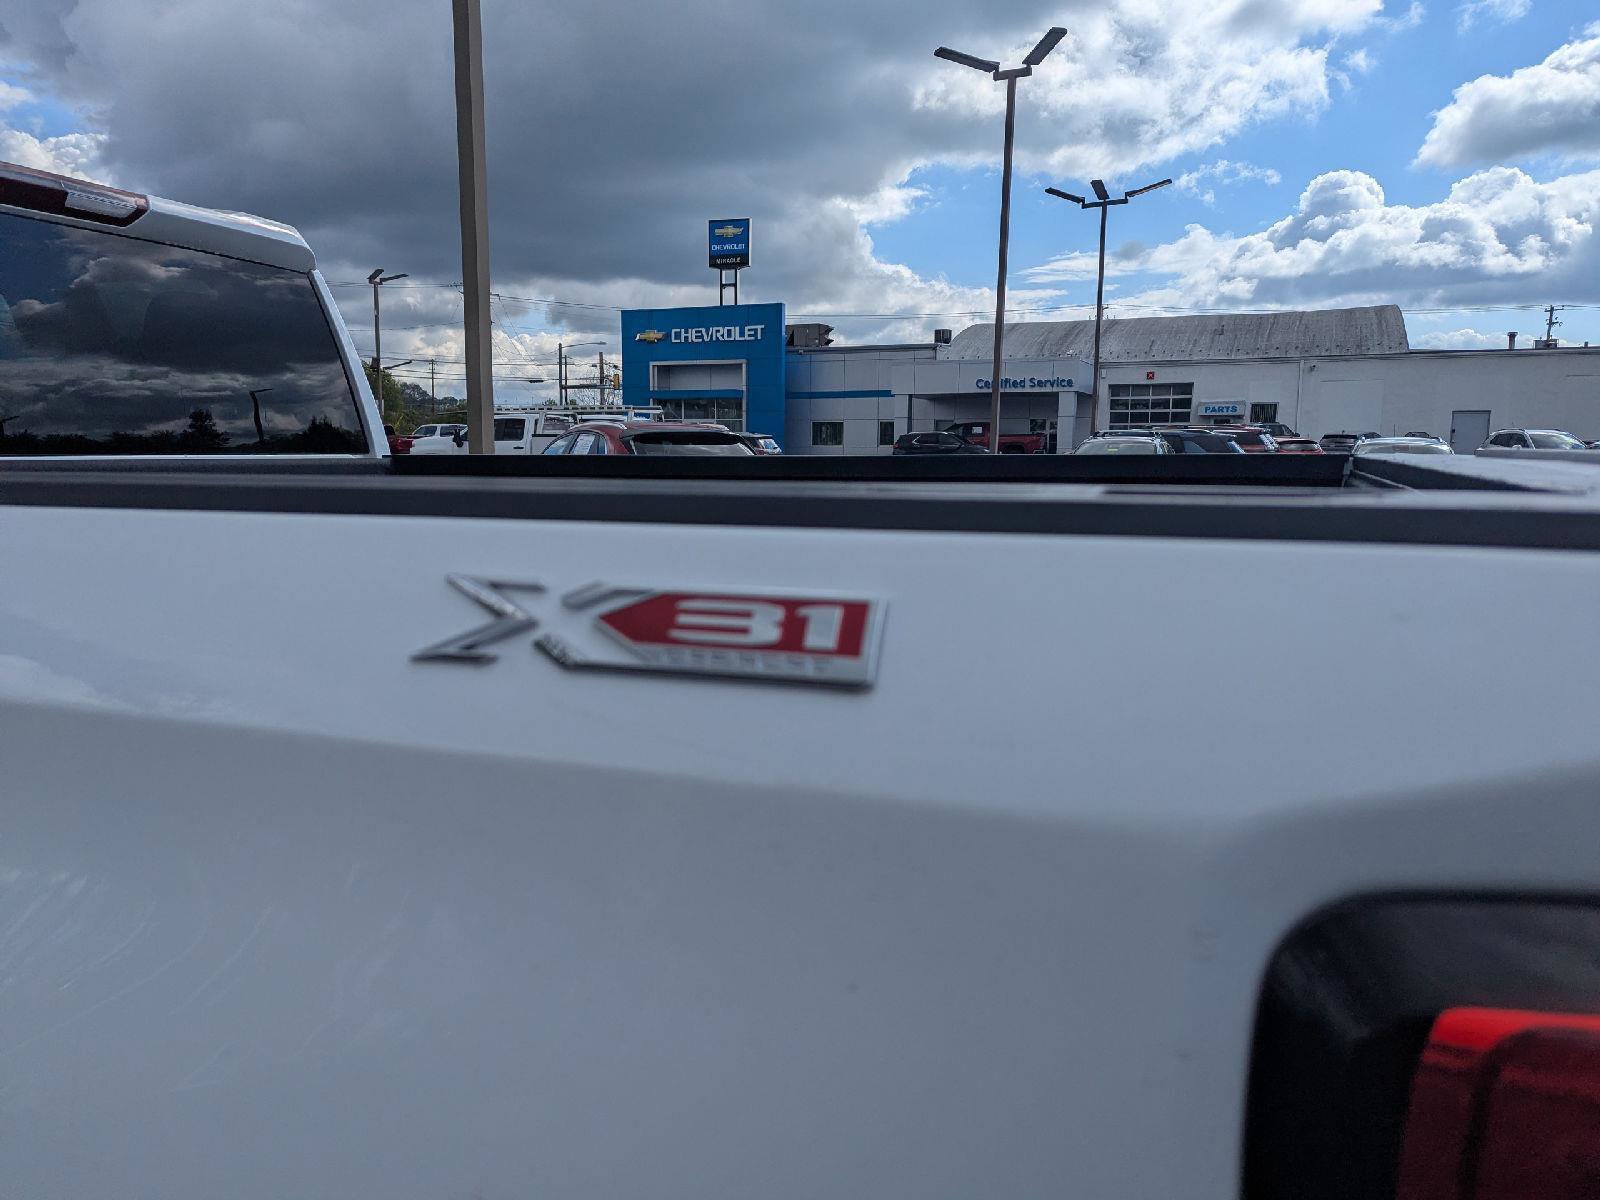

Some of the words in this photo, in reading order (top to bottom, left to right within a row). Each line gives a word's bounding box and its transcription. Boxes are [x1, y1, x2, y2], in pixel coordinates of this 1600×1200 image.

[671, 325, 765, 343] CHEVROLET
[976, 378, 1026, 389] Ceified
[1028, 377, 1074, 388] Service
[1204, 405, 1238, 414] PARTS
